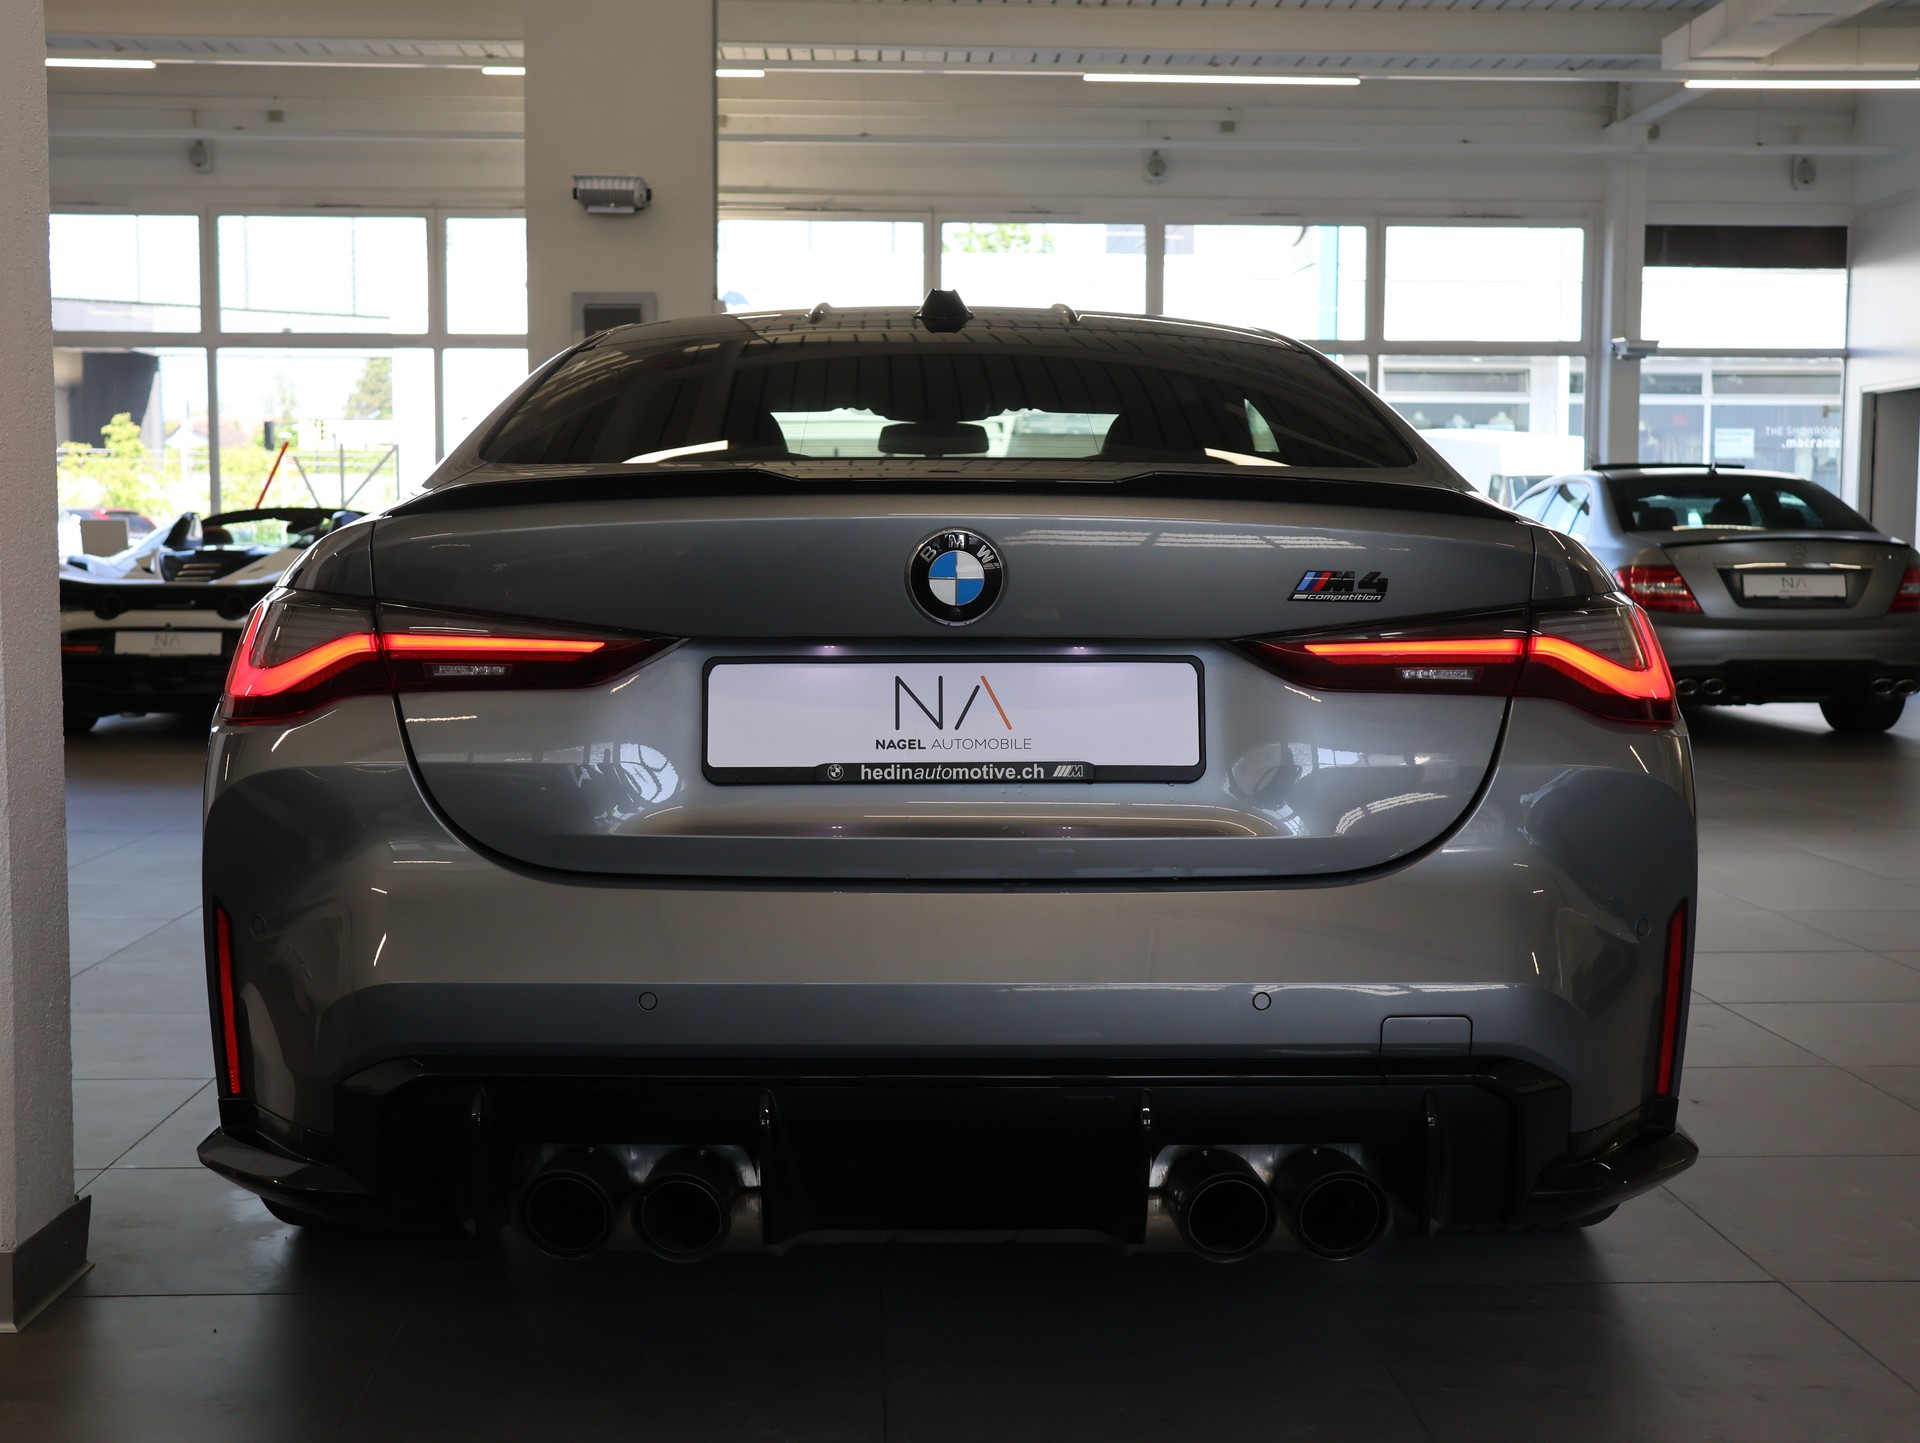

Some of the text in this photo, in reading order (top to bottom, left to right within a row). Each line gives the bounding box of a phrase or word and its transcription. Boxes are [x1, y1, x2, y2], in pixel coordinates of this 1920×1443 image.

[1765, 426, 1783, 436] THE
[919, 534, 995, 563] BMW
[1320, 571, 1389, 592] M4
[895, 675, 1012, 730] NA
[875, 738, 1032, 750] NAGEL AUTOMOBILE
[860, 764, 1045, 780] hedinautomotive.ch
